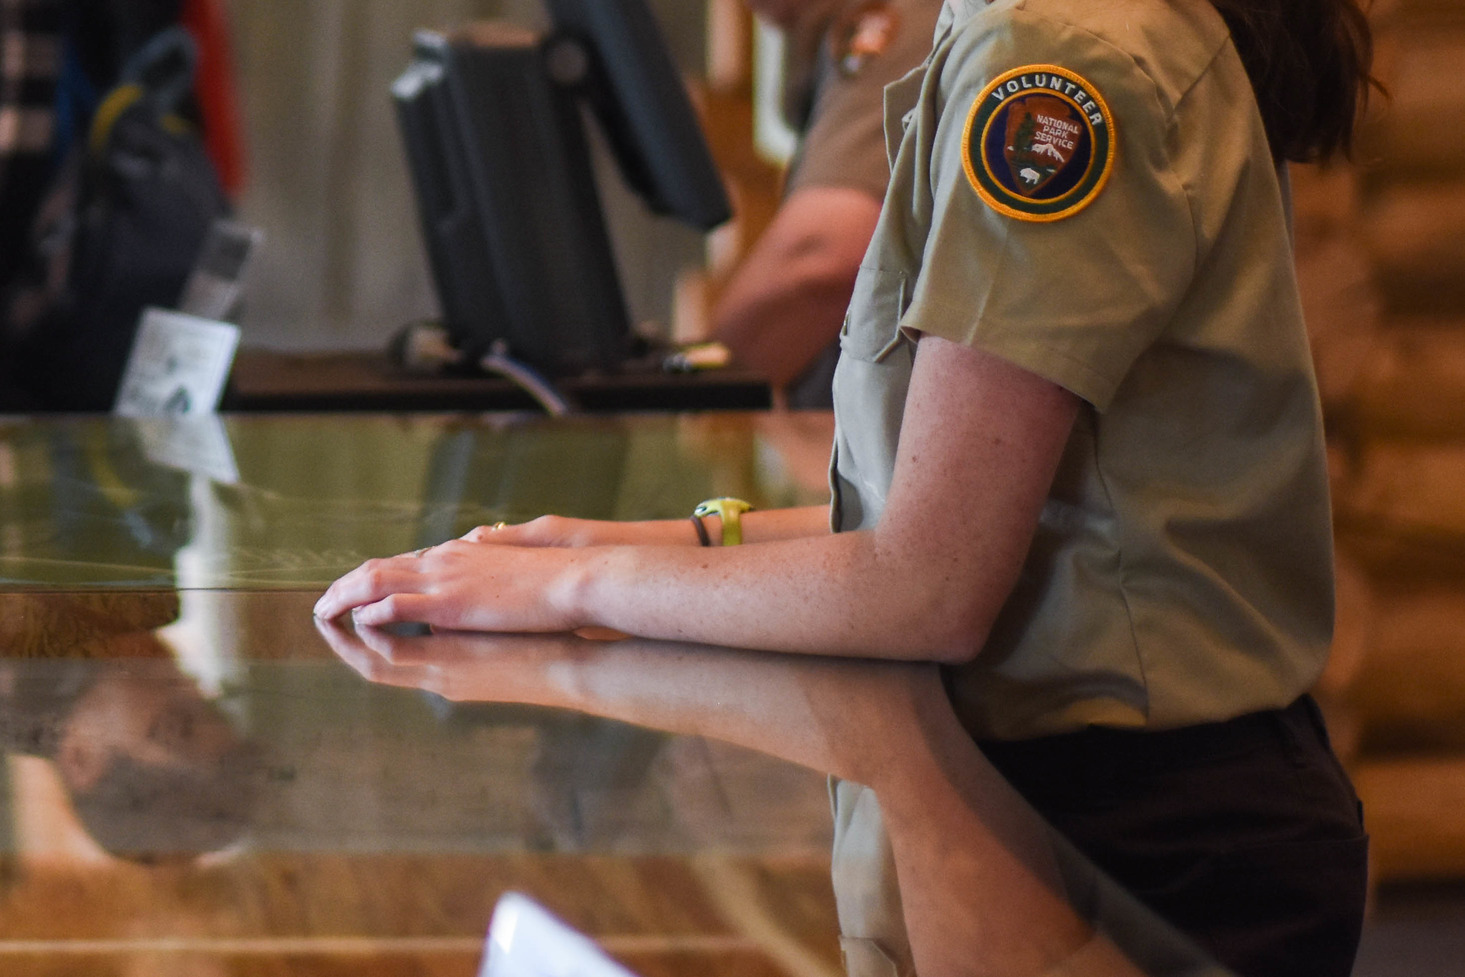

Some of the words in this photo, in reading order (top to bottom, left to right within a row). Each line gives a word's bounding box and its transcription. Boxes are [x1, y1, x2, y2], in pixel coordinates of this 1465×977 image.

[991, 73, 1103, 126] VOLUNTEER
[1036, 113, 1079, 135] NATIONAL
[1043, 124, 1069, 139] PARK
[1034, 130, 1074, 150] SERVICE
